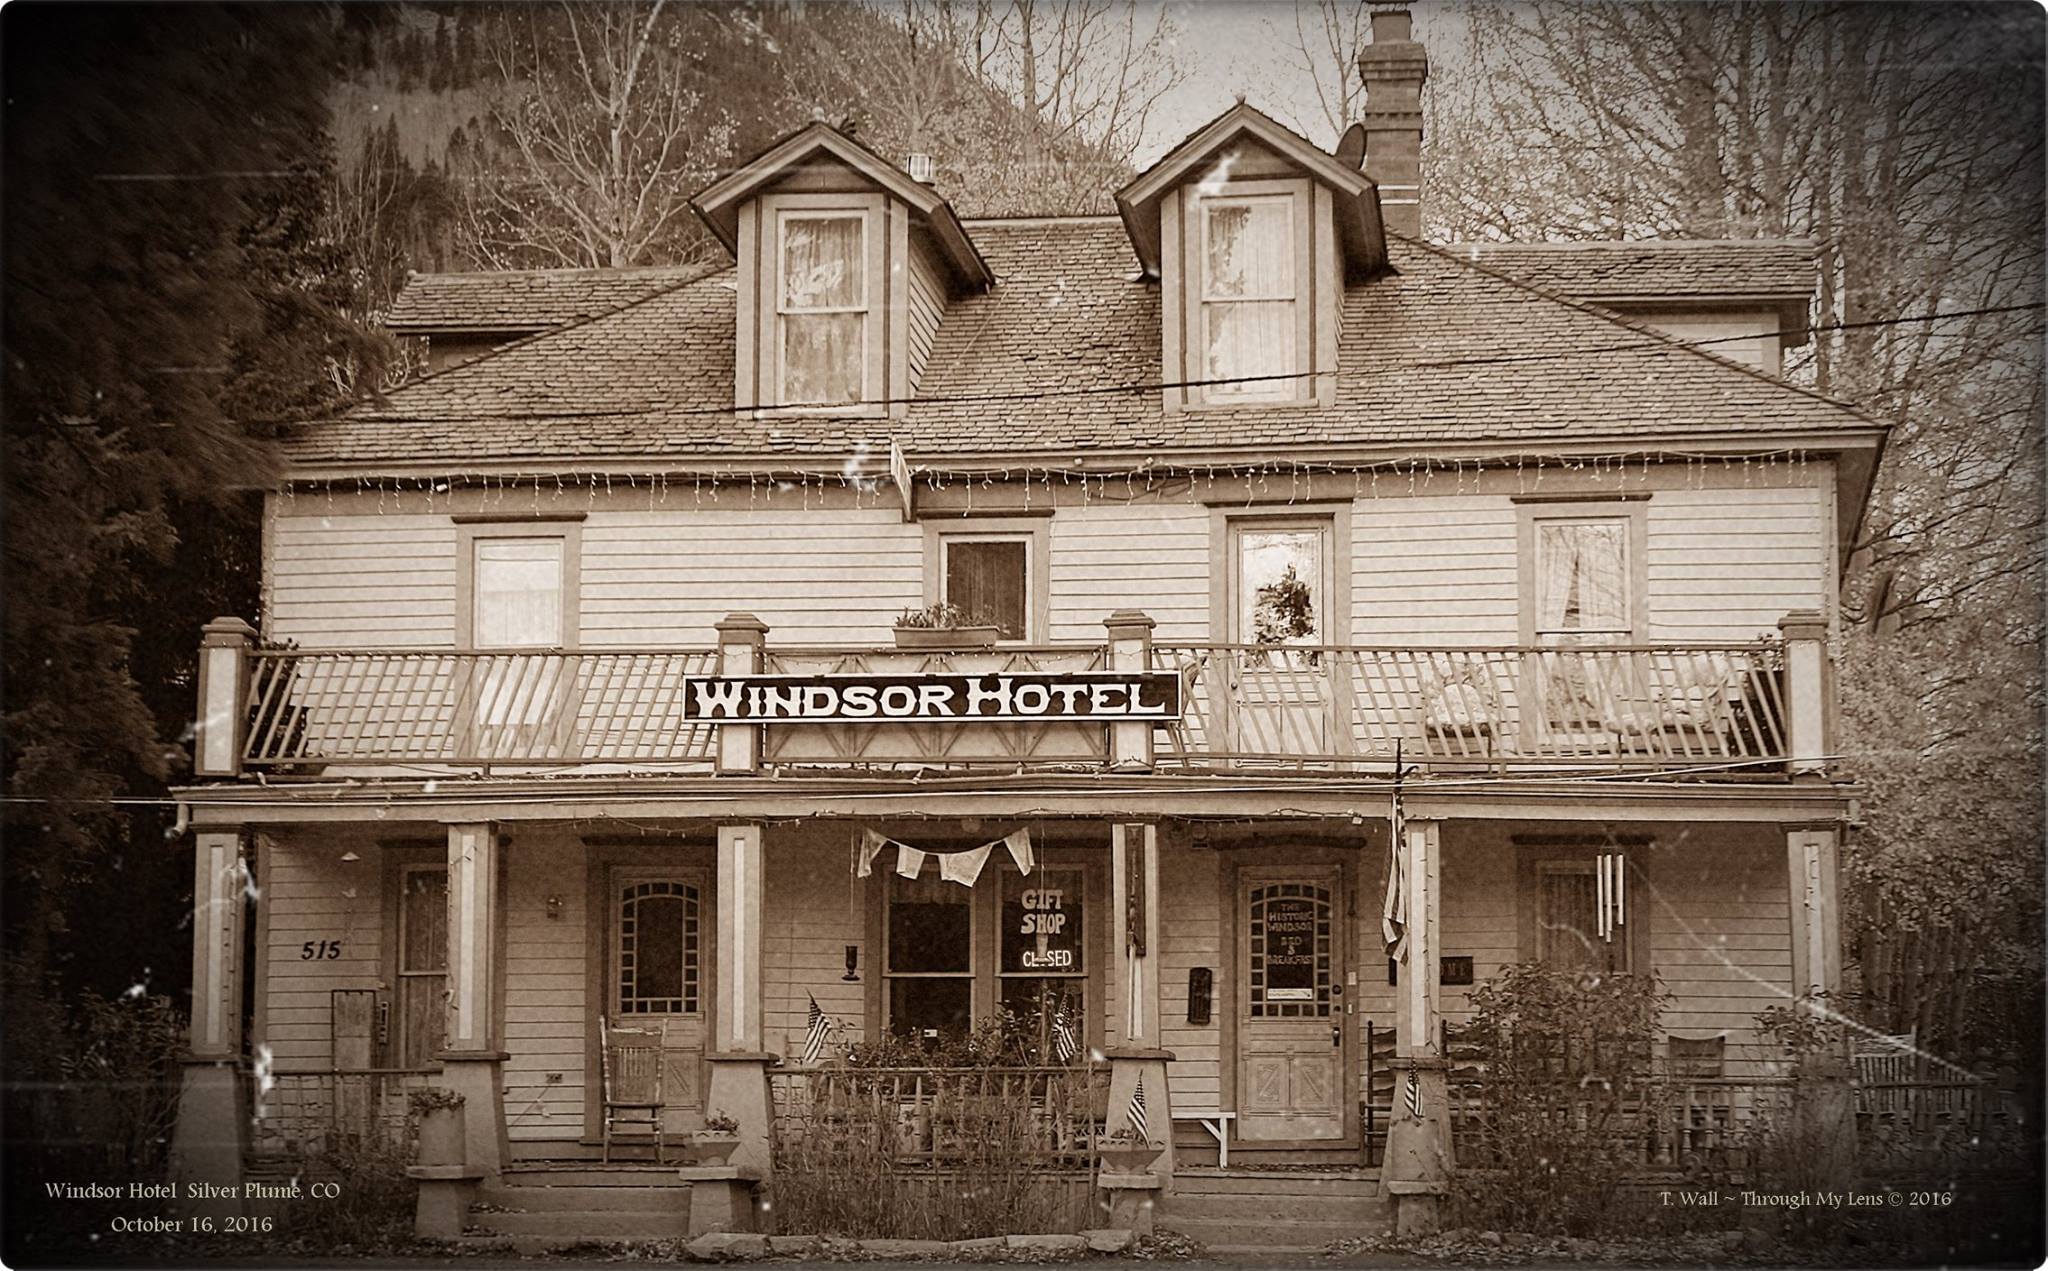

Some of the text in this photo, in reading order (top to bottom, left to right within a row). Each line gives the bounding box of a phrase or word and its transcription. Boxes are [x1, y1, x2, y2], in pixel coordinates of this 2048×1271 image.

[692, 677, 1165, 718] WINDSOR HOTEL
[1022, 889, 1062, 909] GIFT
[1021, 914, 1066, 934] SHOP
[1269, 911, 1313, 921] HISTORIC
[1268, 922, 1312, 932] WINDSOR
[301, 940, 341, 960] 515
[1023, 950, 1071, 967] CLSED
[1267, 955, 1313, 965] BREAKFAS
